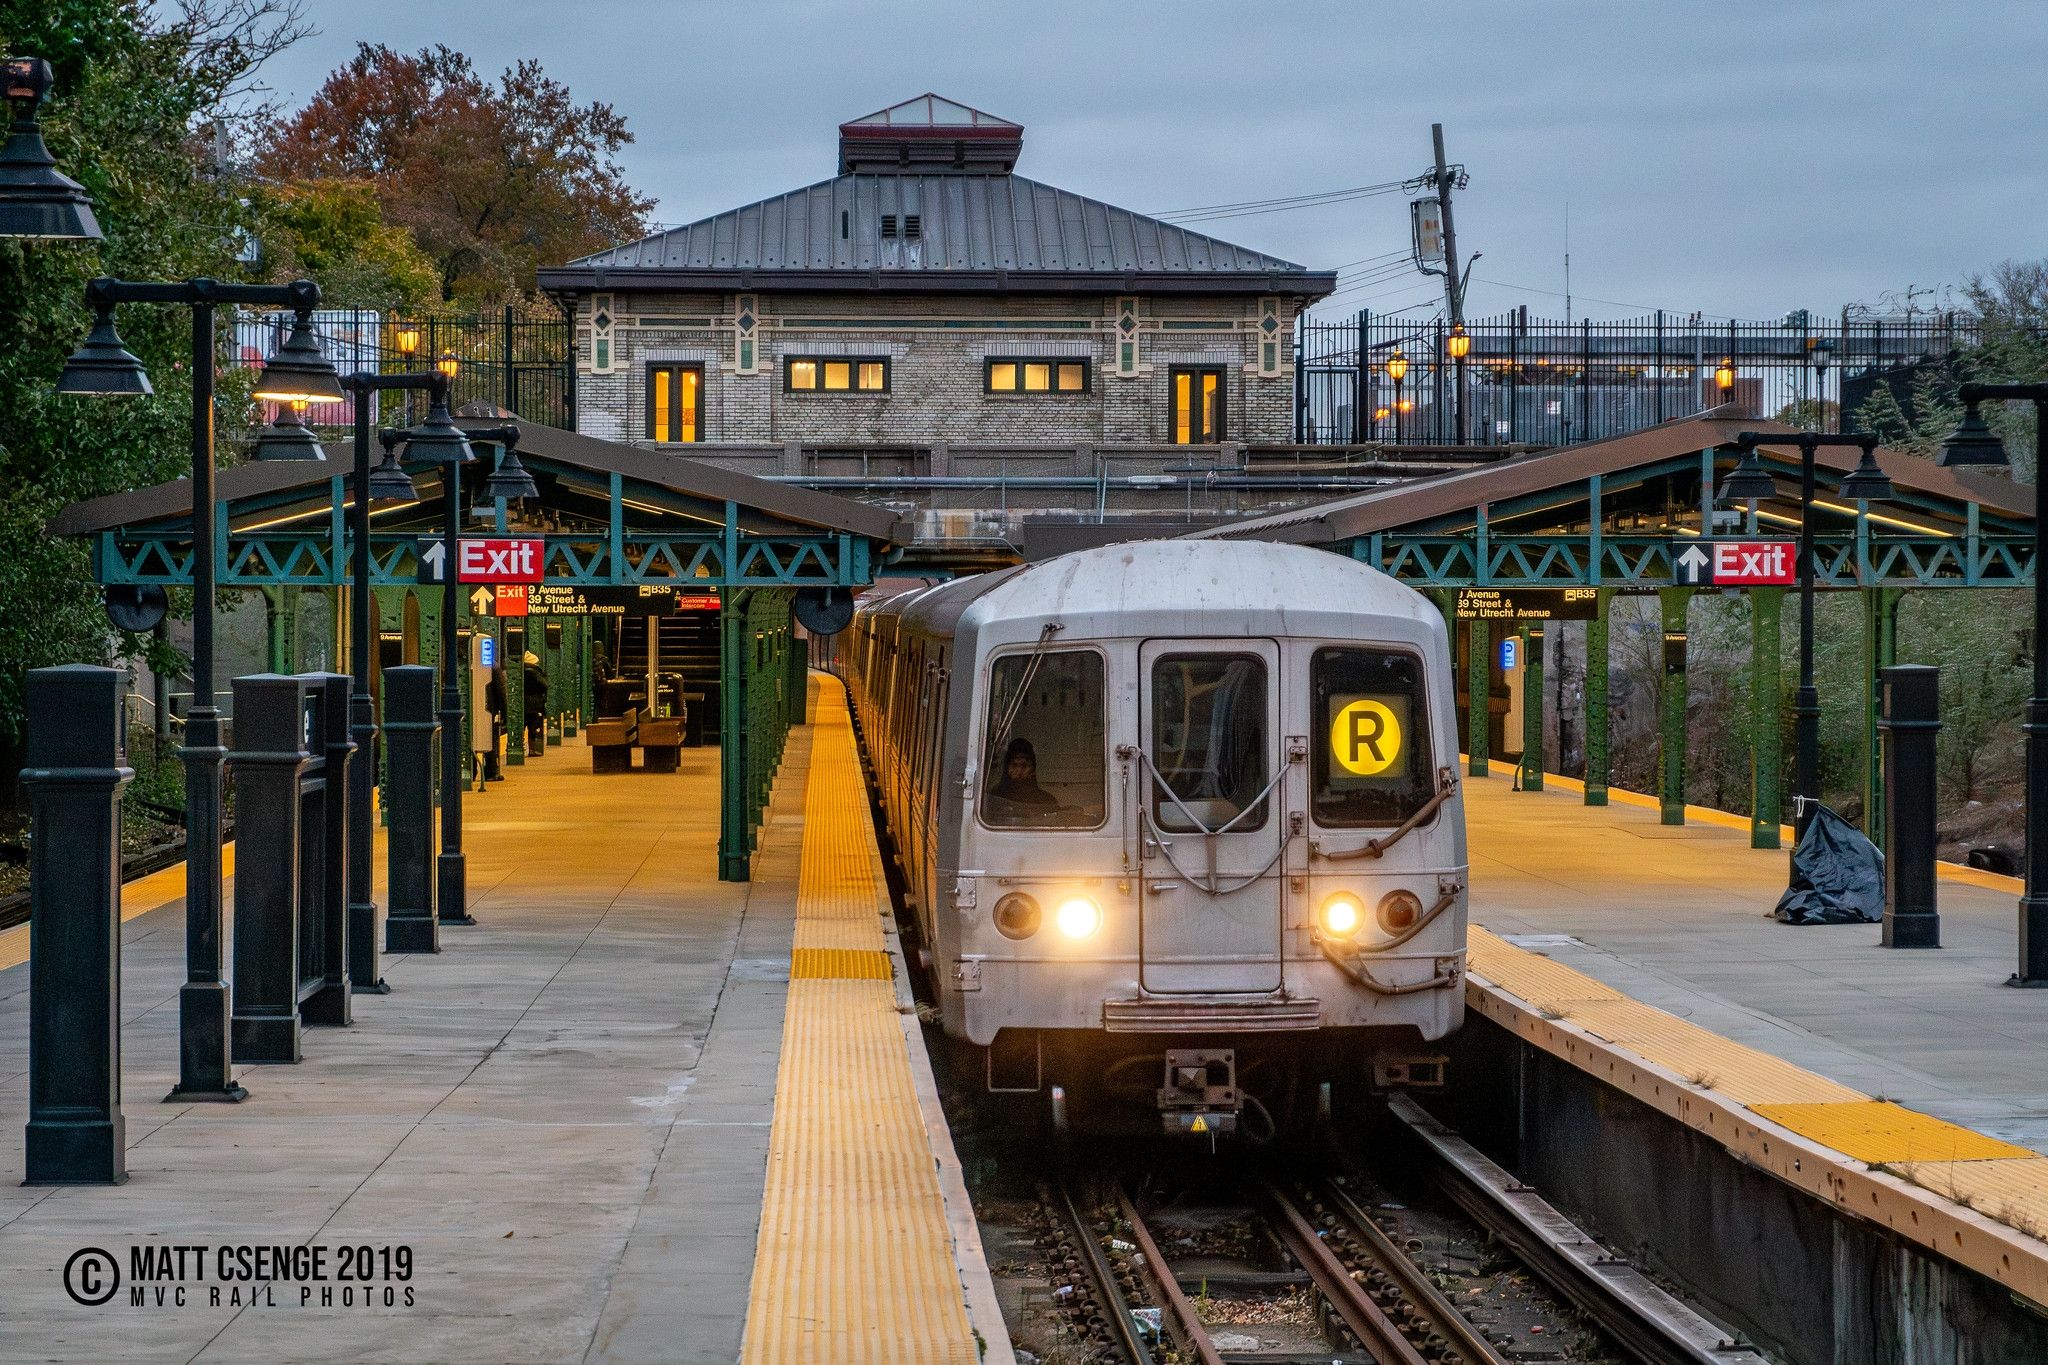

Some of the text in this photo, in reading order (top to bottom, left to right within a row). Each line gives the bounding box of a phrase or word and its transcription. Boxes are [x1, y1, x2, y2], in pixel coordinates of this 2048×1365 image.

[460, 541, 534, 574] Exit
[1716, 544, 1786, 577] Exit
[497, 585, 524, 598] Exit
[528, 586, 573, 594] 9 Avenue
[651, 585, 671, 594] B35
[1466, 590, 1500, 598] Avenue
[1576, 590, 1596, 598] B35
[528, 595, 586, 604] 39 Street &
[1472, 599, 1502, 608] Street
[1505, 599, 1512, 608] &
[528, 604, 625, 613] New Utrecht Avenue
[1457, 609, 1551, 618] New Utrecht Avenue
[1349, 710, 1386, 763] R
